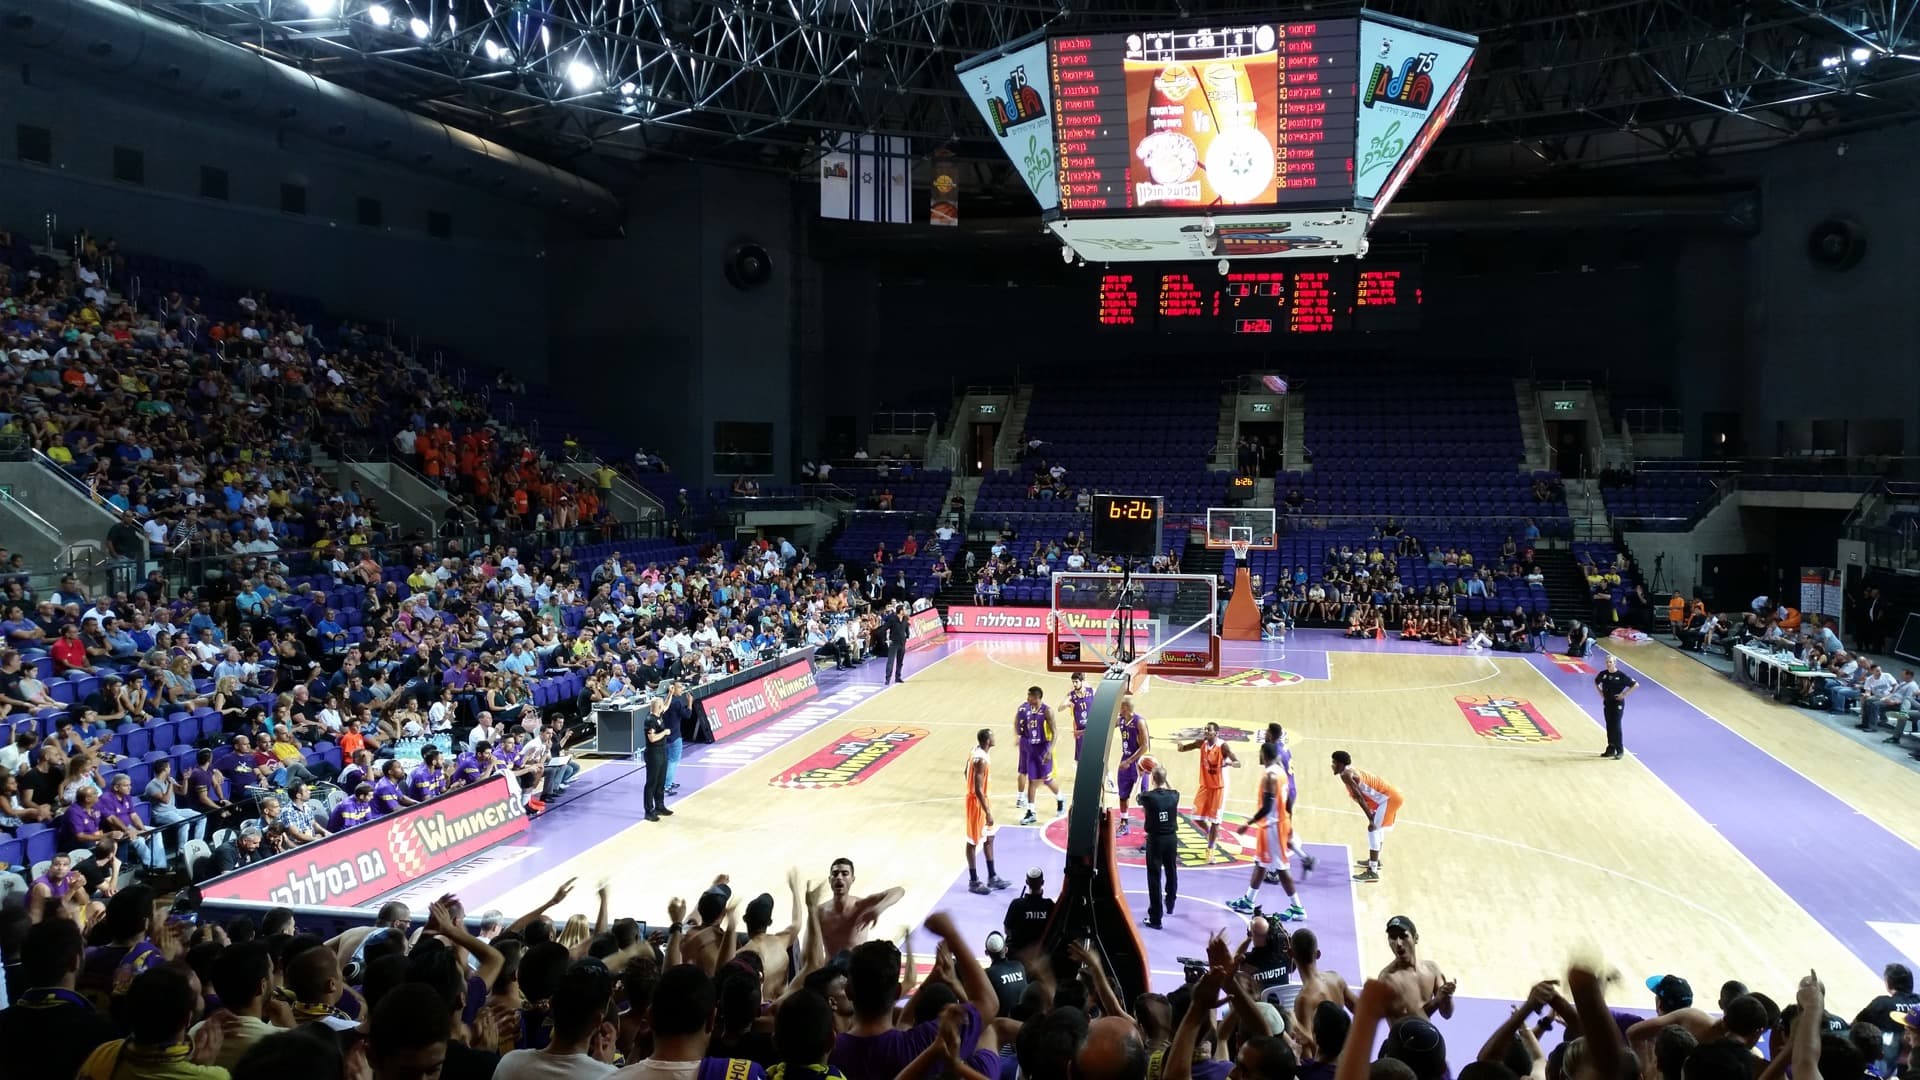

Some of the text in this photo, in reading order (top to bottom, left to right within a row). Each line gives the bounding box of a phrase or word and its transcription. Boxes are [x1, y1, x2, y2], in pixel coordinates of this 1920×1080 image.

[1280, 41, 1285, 53] 7
[1053, 54, 1058, 66] 3
[1280, 57, 1285, 69] 8
[1416, 53, 1438, 74] 75
[1009, 65, 1027, 90] 75
[1054, 70, 1060, 81] 6
[1280, 72, 1285, 84] 9
[1055, 85, 1060, 96] 7
[1057, 99, 1062, 111] 8
[1280, 103, 1287, 114] 11
[1058, 113, 1063, 126] 9
[1059, 128, 1066, 140] 11
[1277, 147, 1287, 159] 23
[1060, 170, 1070, 182] 21
[1060, 184, 1071, 196] 43
[1139, 184, 1198, 200] הפועל חולון
[1062, 198, 1072, 210] 91
[1235, 478, 1252, 486] 6:26
[1110, 501, 1152, 519] 6:26
[1025, 616, 1041, 629] גם
[752, 692, 766, 711] גם
[1080, 702, 1087, 711] 11
[763, 706, 840, 730] טוטו
[1031, 719, 1046, 729] 21
[1494, 705, 1547, 737] Winner
[697, 732, 797, 763] חולון
[793, 740, 899, 783] Winner
[358, 848, 386, 884] גם
[1025, 915, 1046, 925] צוות
[1001, 968, 1023, 990] צוות
[1253, 965, 1286, 985] תקשורת
